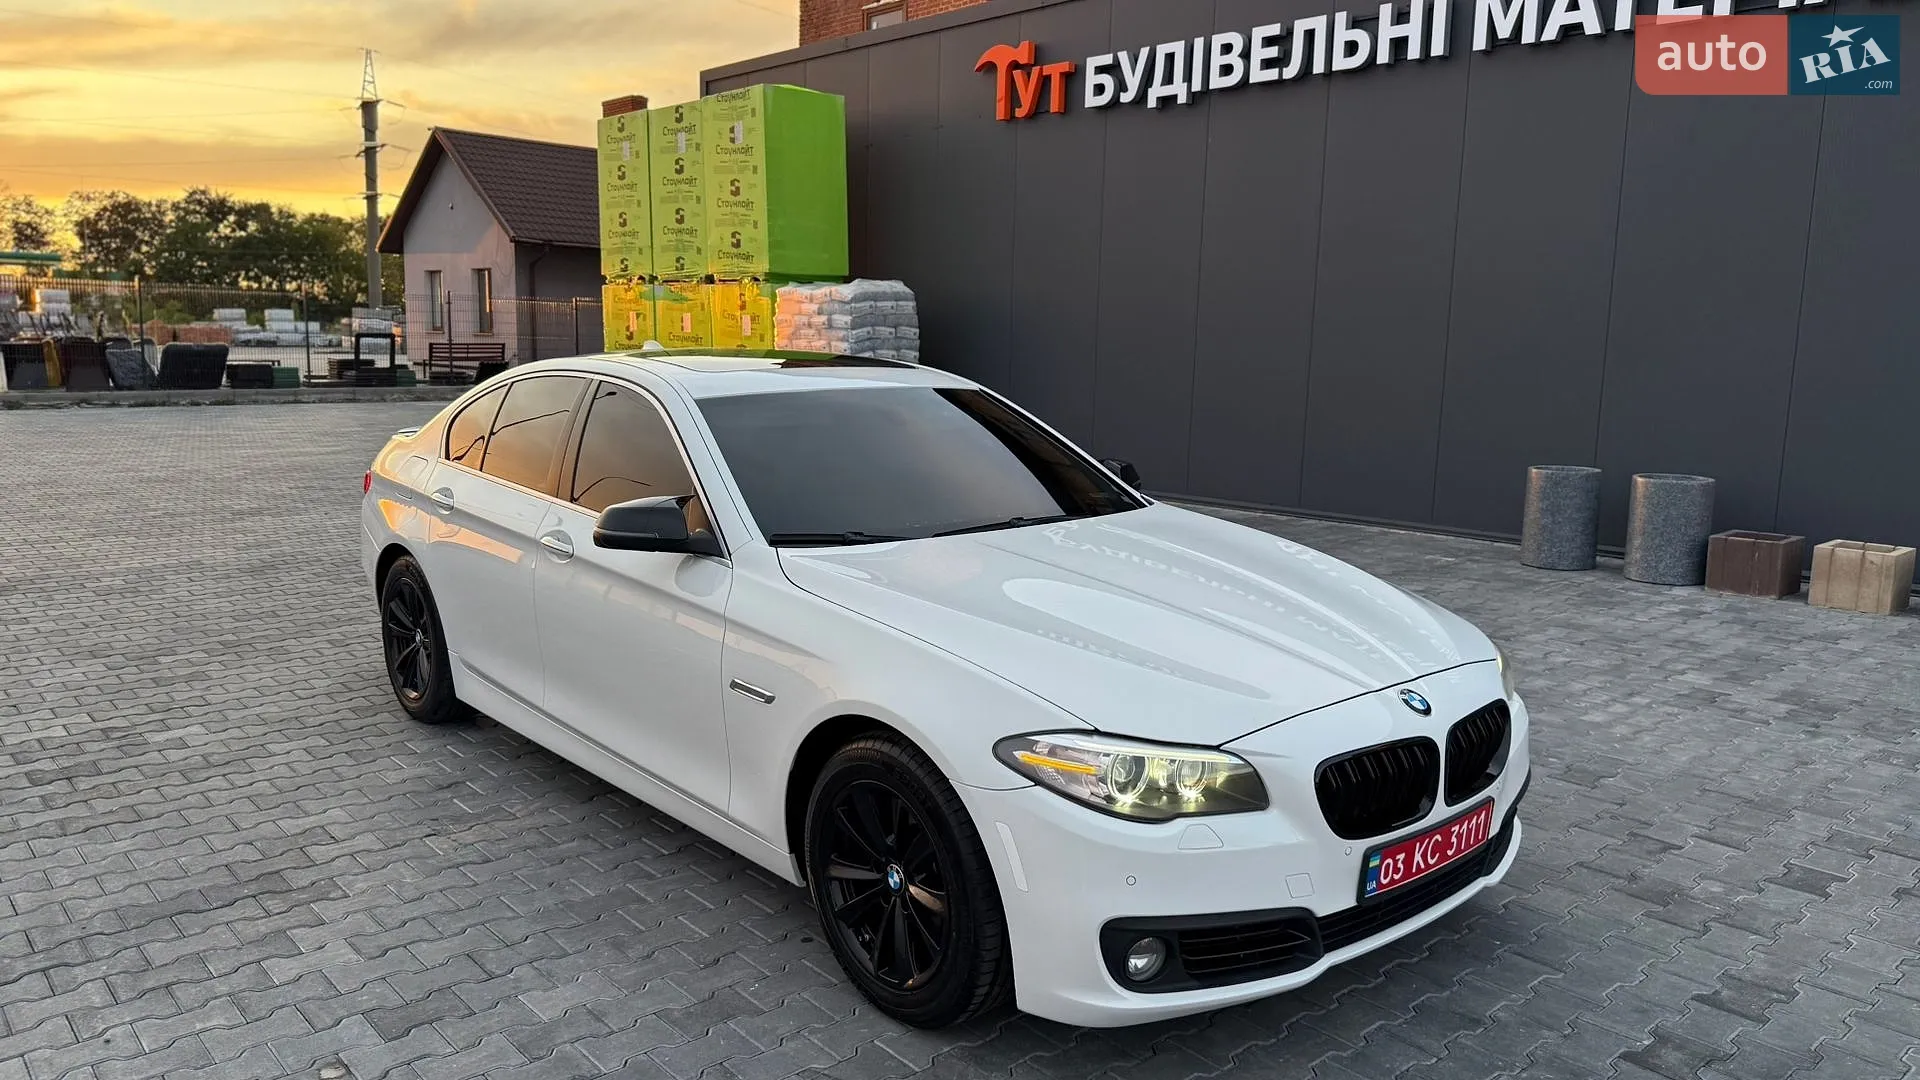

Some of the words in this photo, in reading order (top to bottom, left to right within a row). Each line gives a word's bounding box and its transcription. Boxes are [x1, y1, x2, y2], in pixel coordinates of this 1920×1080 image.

[1084, 0, 1449, 109] БУДІВЕЛЬНІ
[1380, 852, 1406, 885] 03
[1412, 833, 1442, 873] KC
[1446, 810, 1486, 857] 3111
